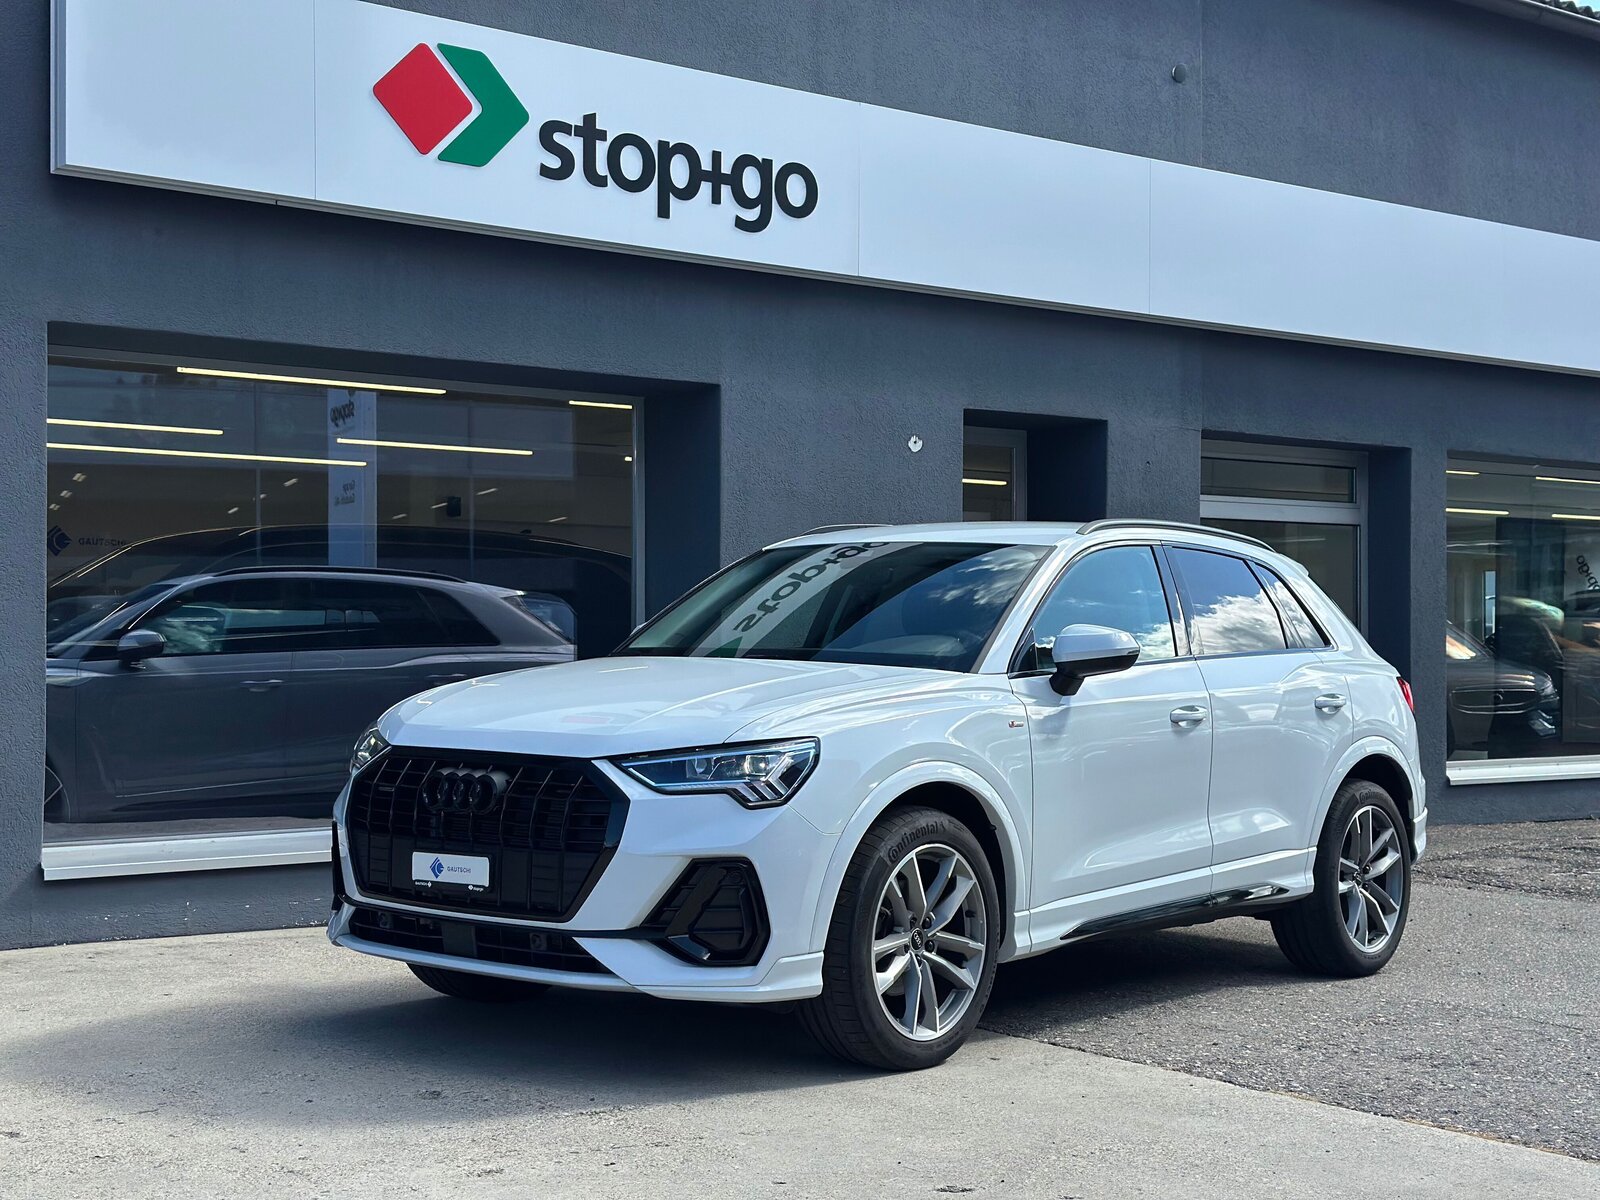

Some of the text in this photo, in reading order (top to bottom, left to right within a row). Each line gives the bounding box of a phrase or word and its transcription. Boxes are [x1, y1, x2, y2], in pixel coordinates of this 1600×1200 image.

[539, 112, 819, 233] stop+go
[888, 821, 939, 863] Continental
[446, 866, 472, 874] GAUTSCHI
